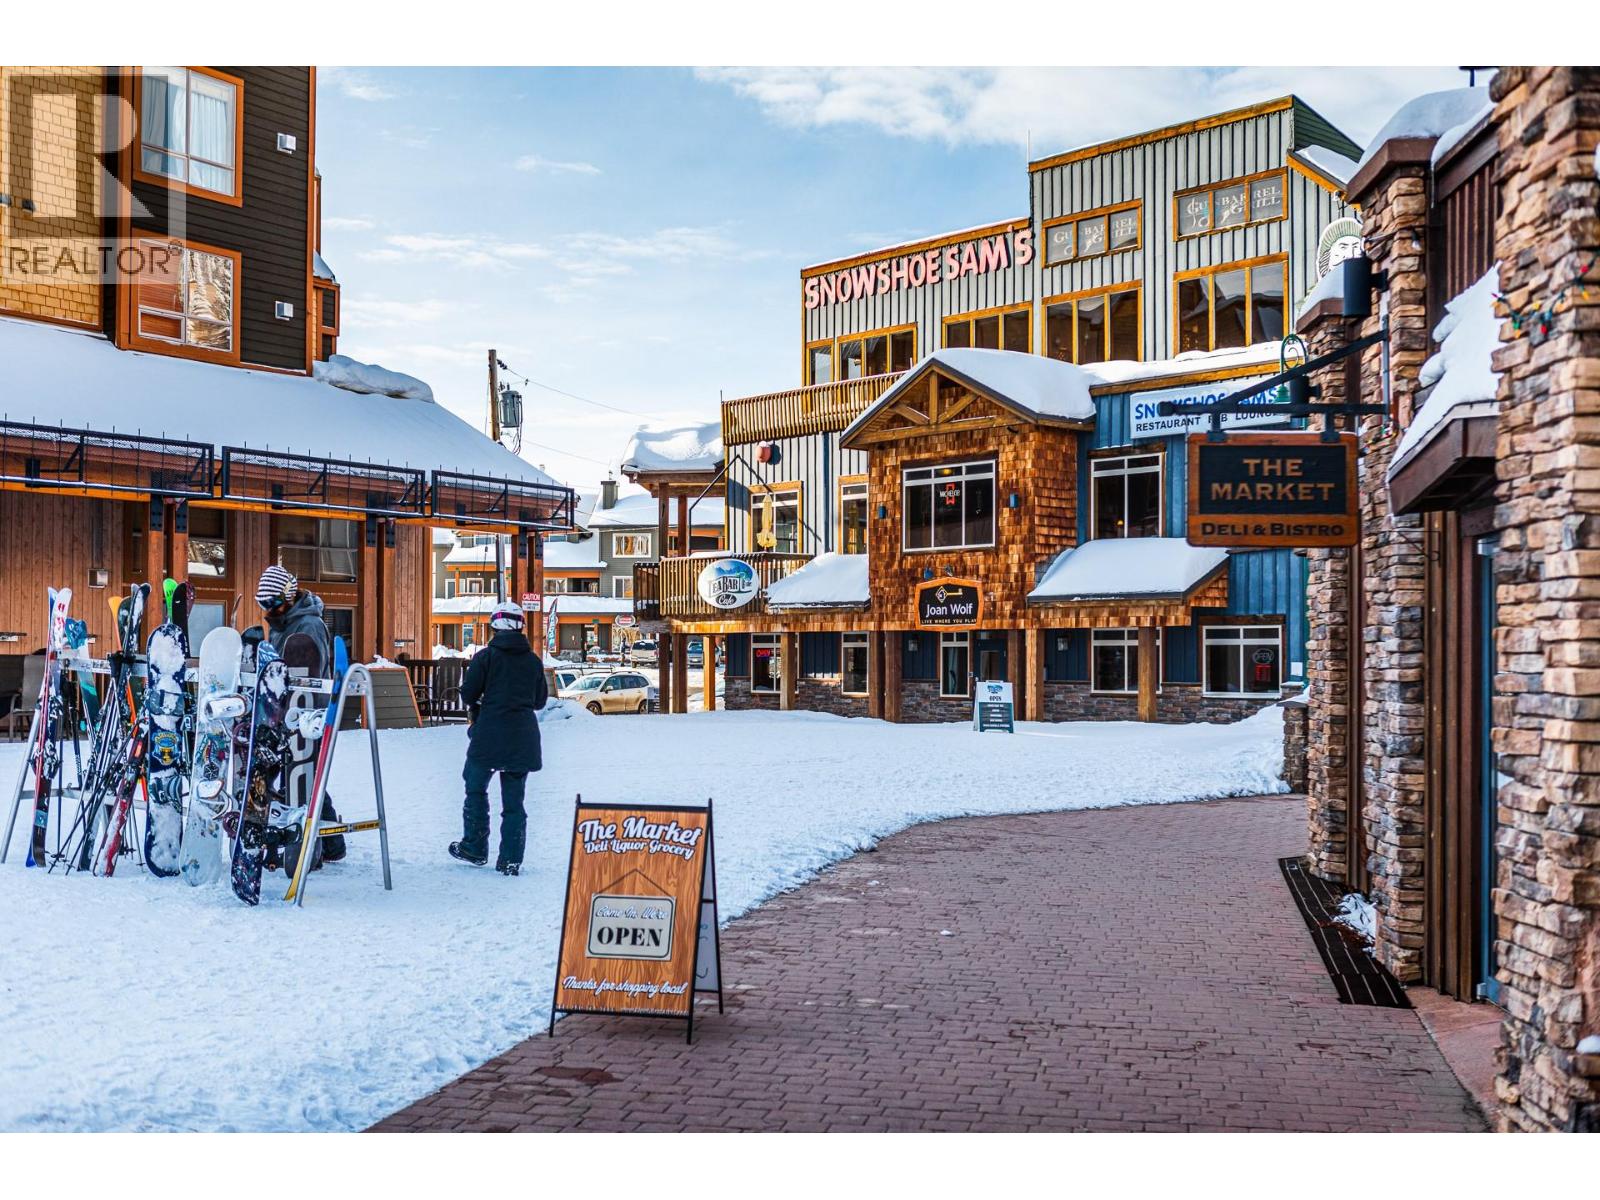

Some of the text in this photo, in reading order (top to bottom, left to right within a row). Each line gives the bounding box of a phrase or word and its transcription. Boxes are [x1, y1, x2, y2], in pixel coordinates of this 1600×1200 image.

[804, 225, 1034, 310] SNOWSHOE SAM'S
[1136, 416, 1201, 432] RESTAURANT
[1208, 412, 1228, 424] PB
[1243, 458, 1303, 476] THE
[1211, 482, 1335, 501] MARKET
[1202, 522, 1344, 536] DELI & BISTRO
[926, 603, 973, 618] Joan Wolf
[578, 816, 702, 846] The Market
[584, 839, 696, 860] Deli Liquor Grocery
[595, 904, 623, 918] Come
[597, 926, 663, 947] OPEN
[562, 975, 689, 999] Thanks for shopping local
